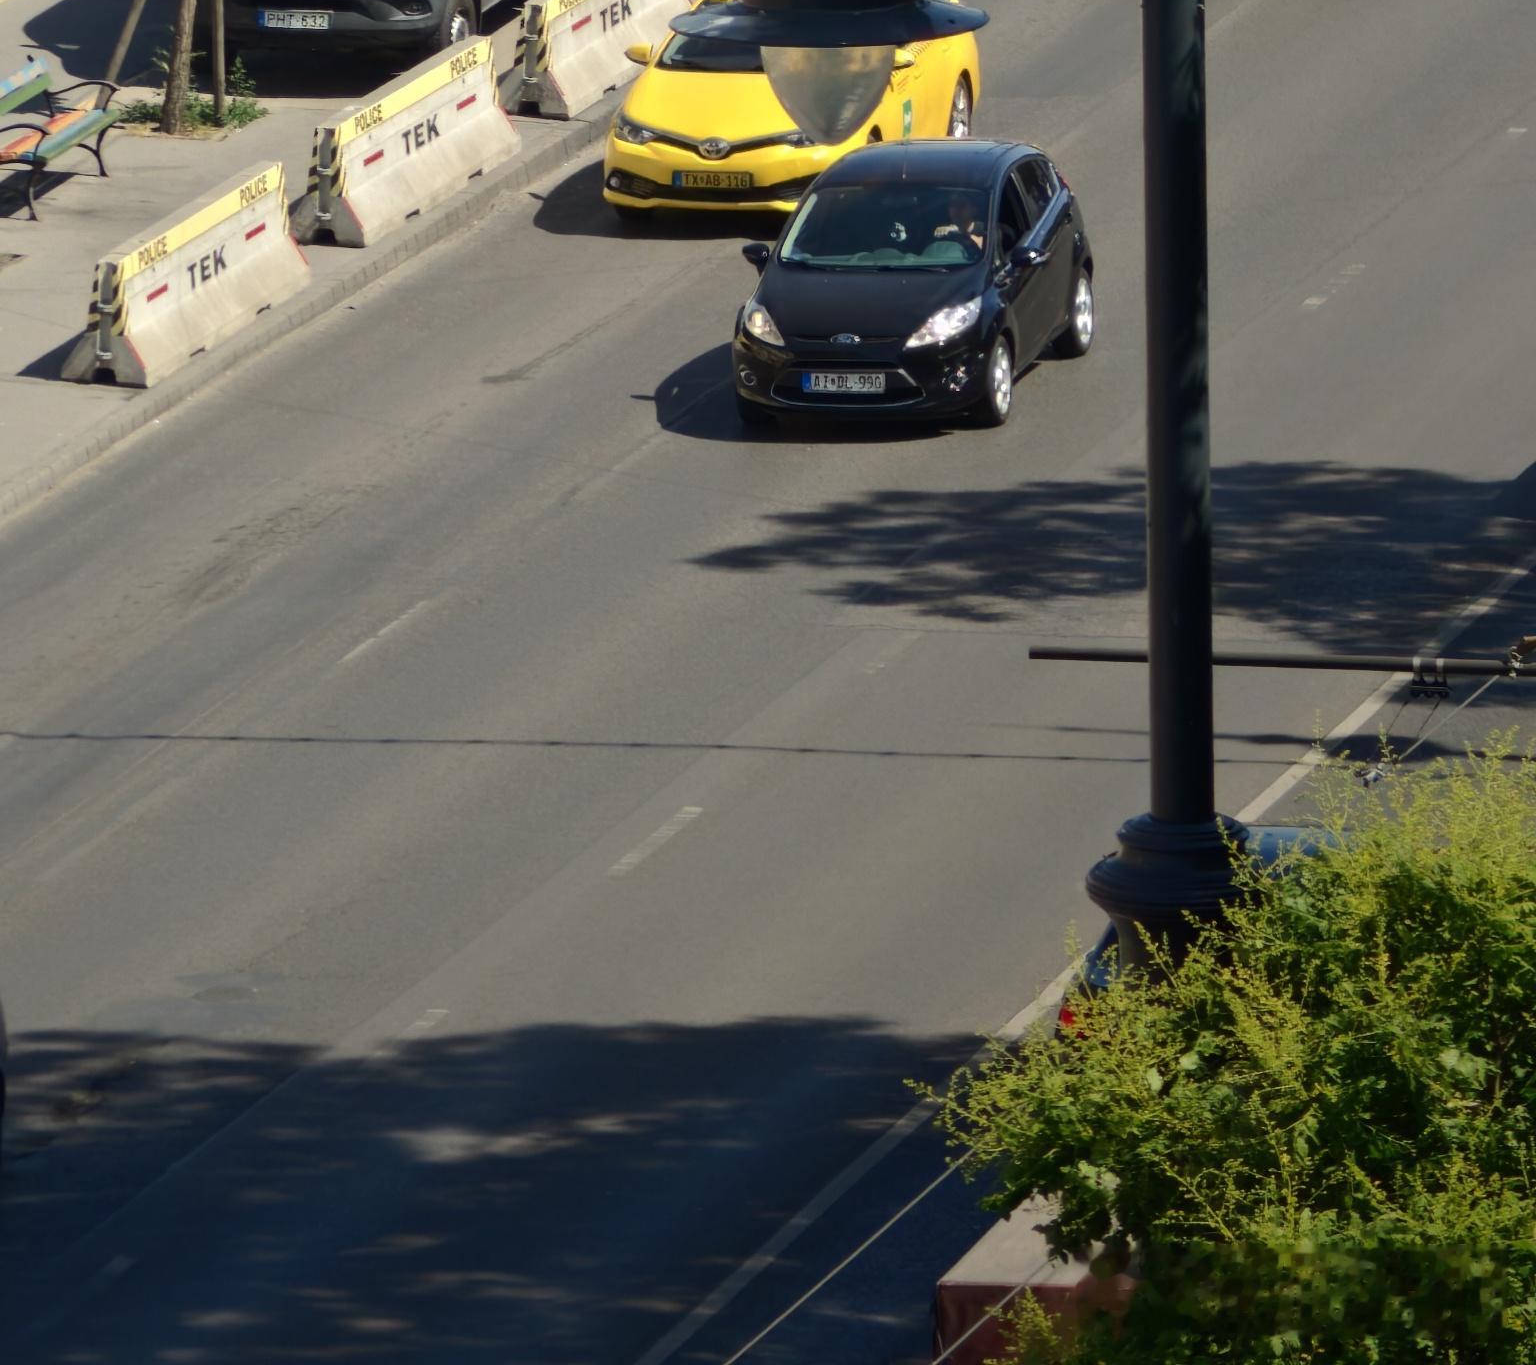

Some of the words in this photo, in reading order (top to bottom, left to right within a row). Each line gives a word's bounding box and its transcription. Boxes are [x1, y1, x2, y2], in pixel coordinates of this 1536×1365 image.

[449, 47, 478, 79] POLICE
[353, 103, 383, 134] POLICE
[401, 113, 441, 156] TEK
[239, 173, 268, 208] POLICE
[137, 235, 168, 270] POLICE
[186, 244, 227, 290] TEK
